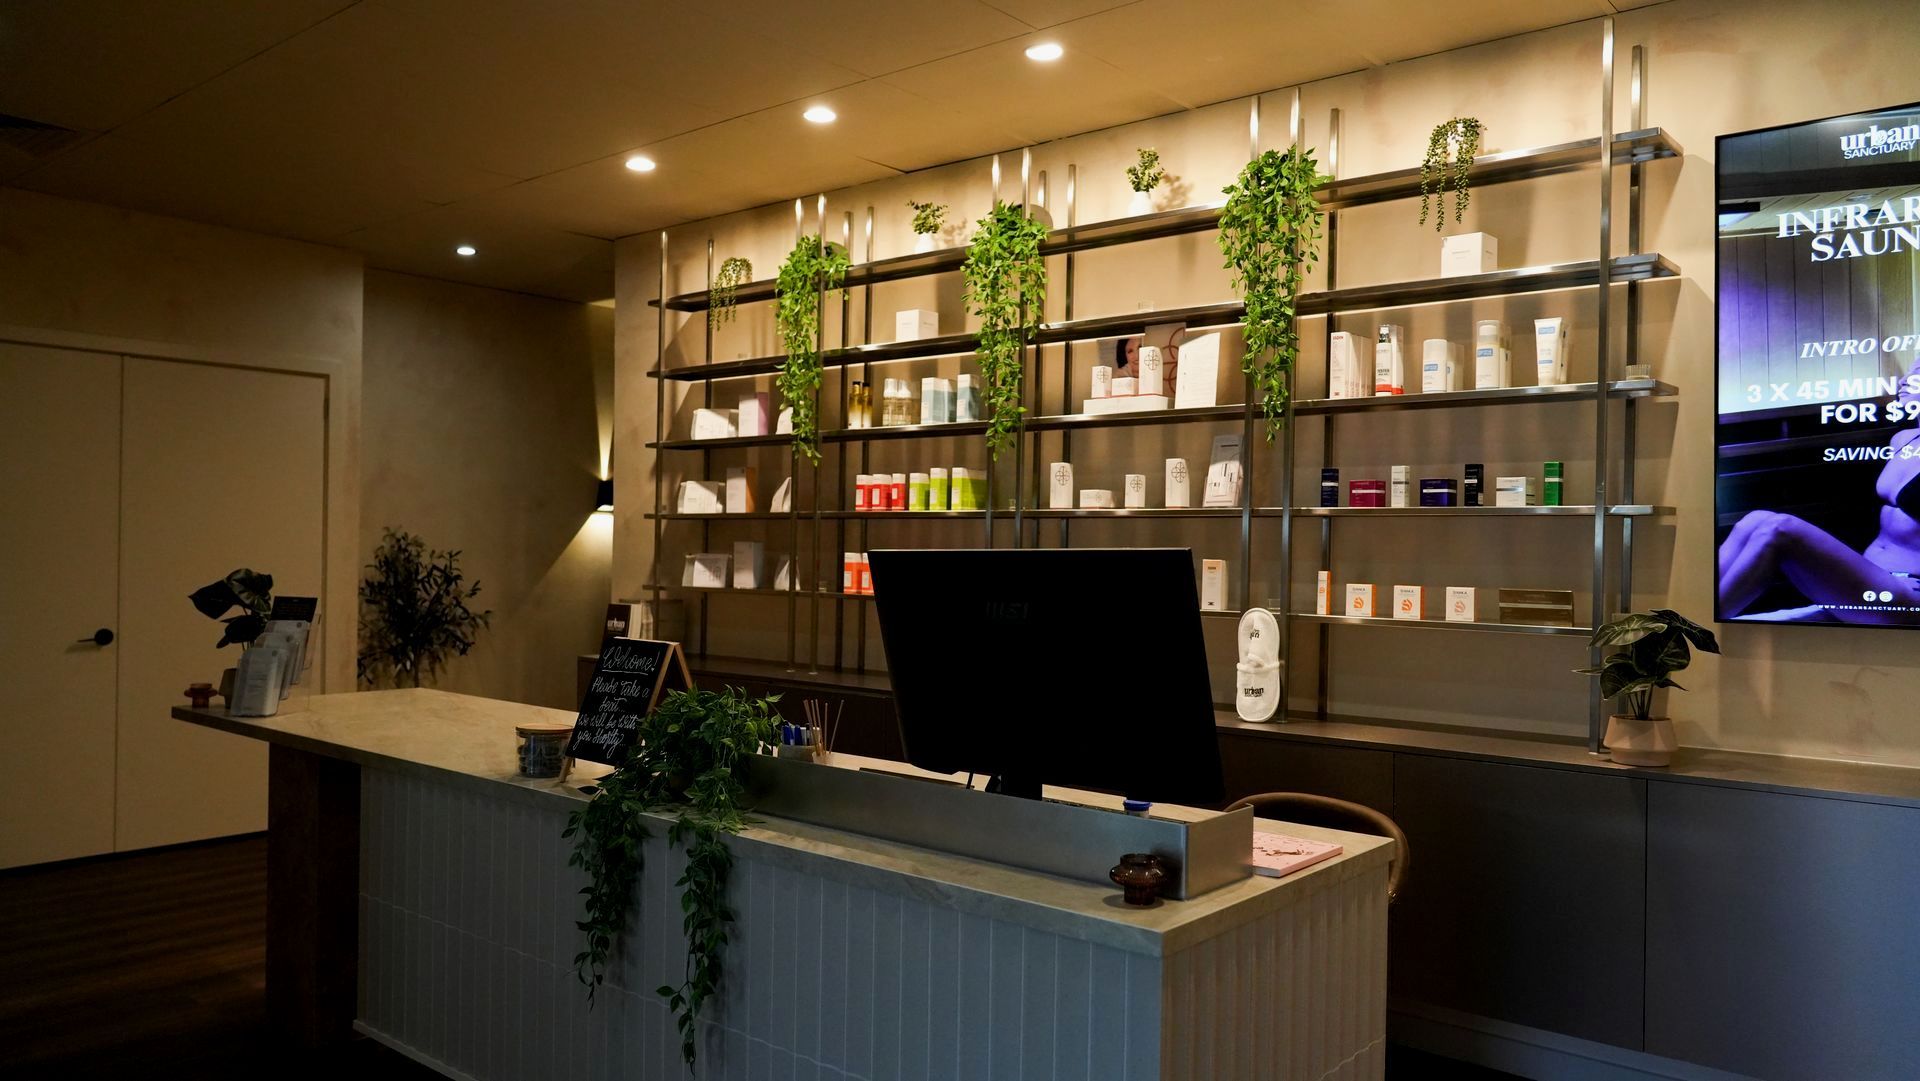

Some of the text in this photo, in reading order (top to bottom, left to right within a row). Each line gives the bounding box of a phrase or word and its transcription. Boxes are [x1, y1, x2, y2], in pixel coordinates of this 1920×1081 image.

[1840, 124, 1920, 150] urban
[1844, 140, 1915, 159] SANCTUARY
[1811, 225, 1920, 262] SAUN
[1800, 338, 1876, 358] INTRO
[1747, 384, 1762, 403] 3
[1770, 383, 1790, 402] X
[1797, 380, 1830, 400] 45
[1838, 376, 1898, 399] MIN
[1821, 400, 1920, 425] FOR $9
[1823, 446, 1895, 461] SAVING
[603, 646, 660, 672] Welcome!
[605, 715, 615, 729] be
[573, 731, 591, 750] you
